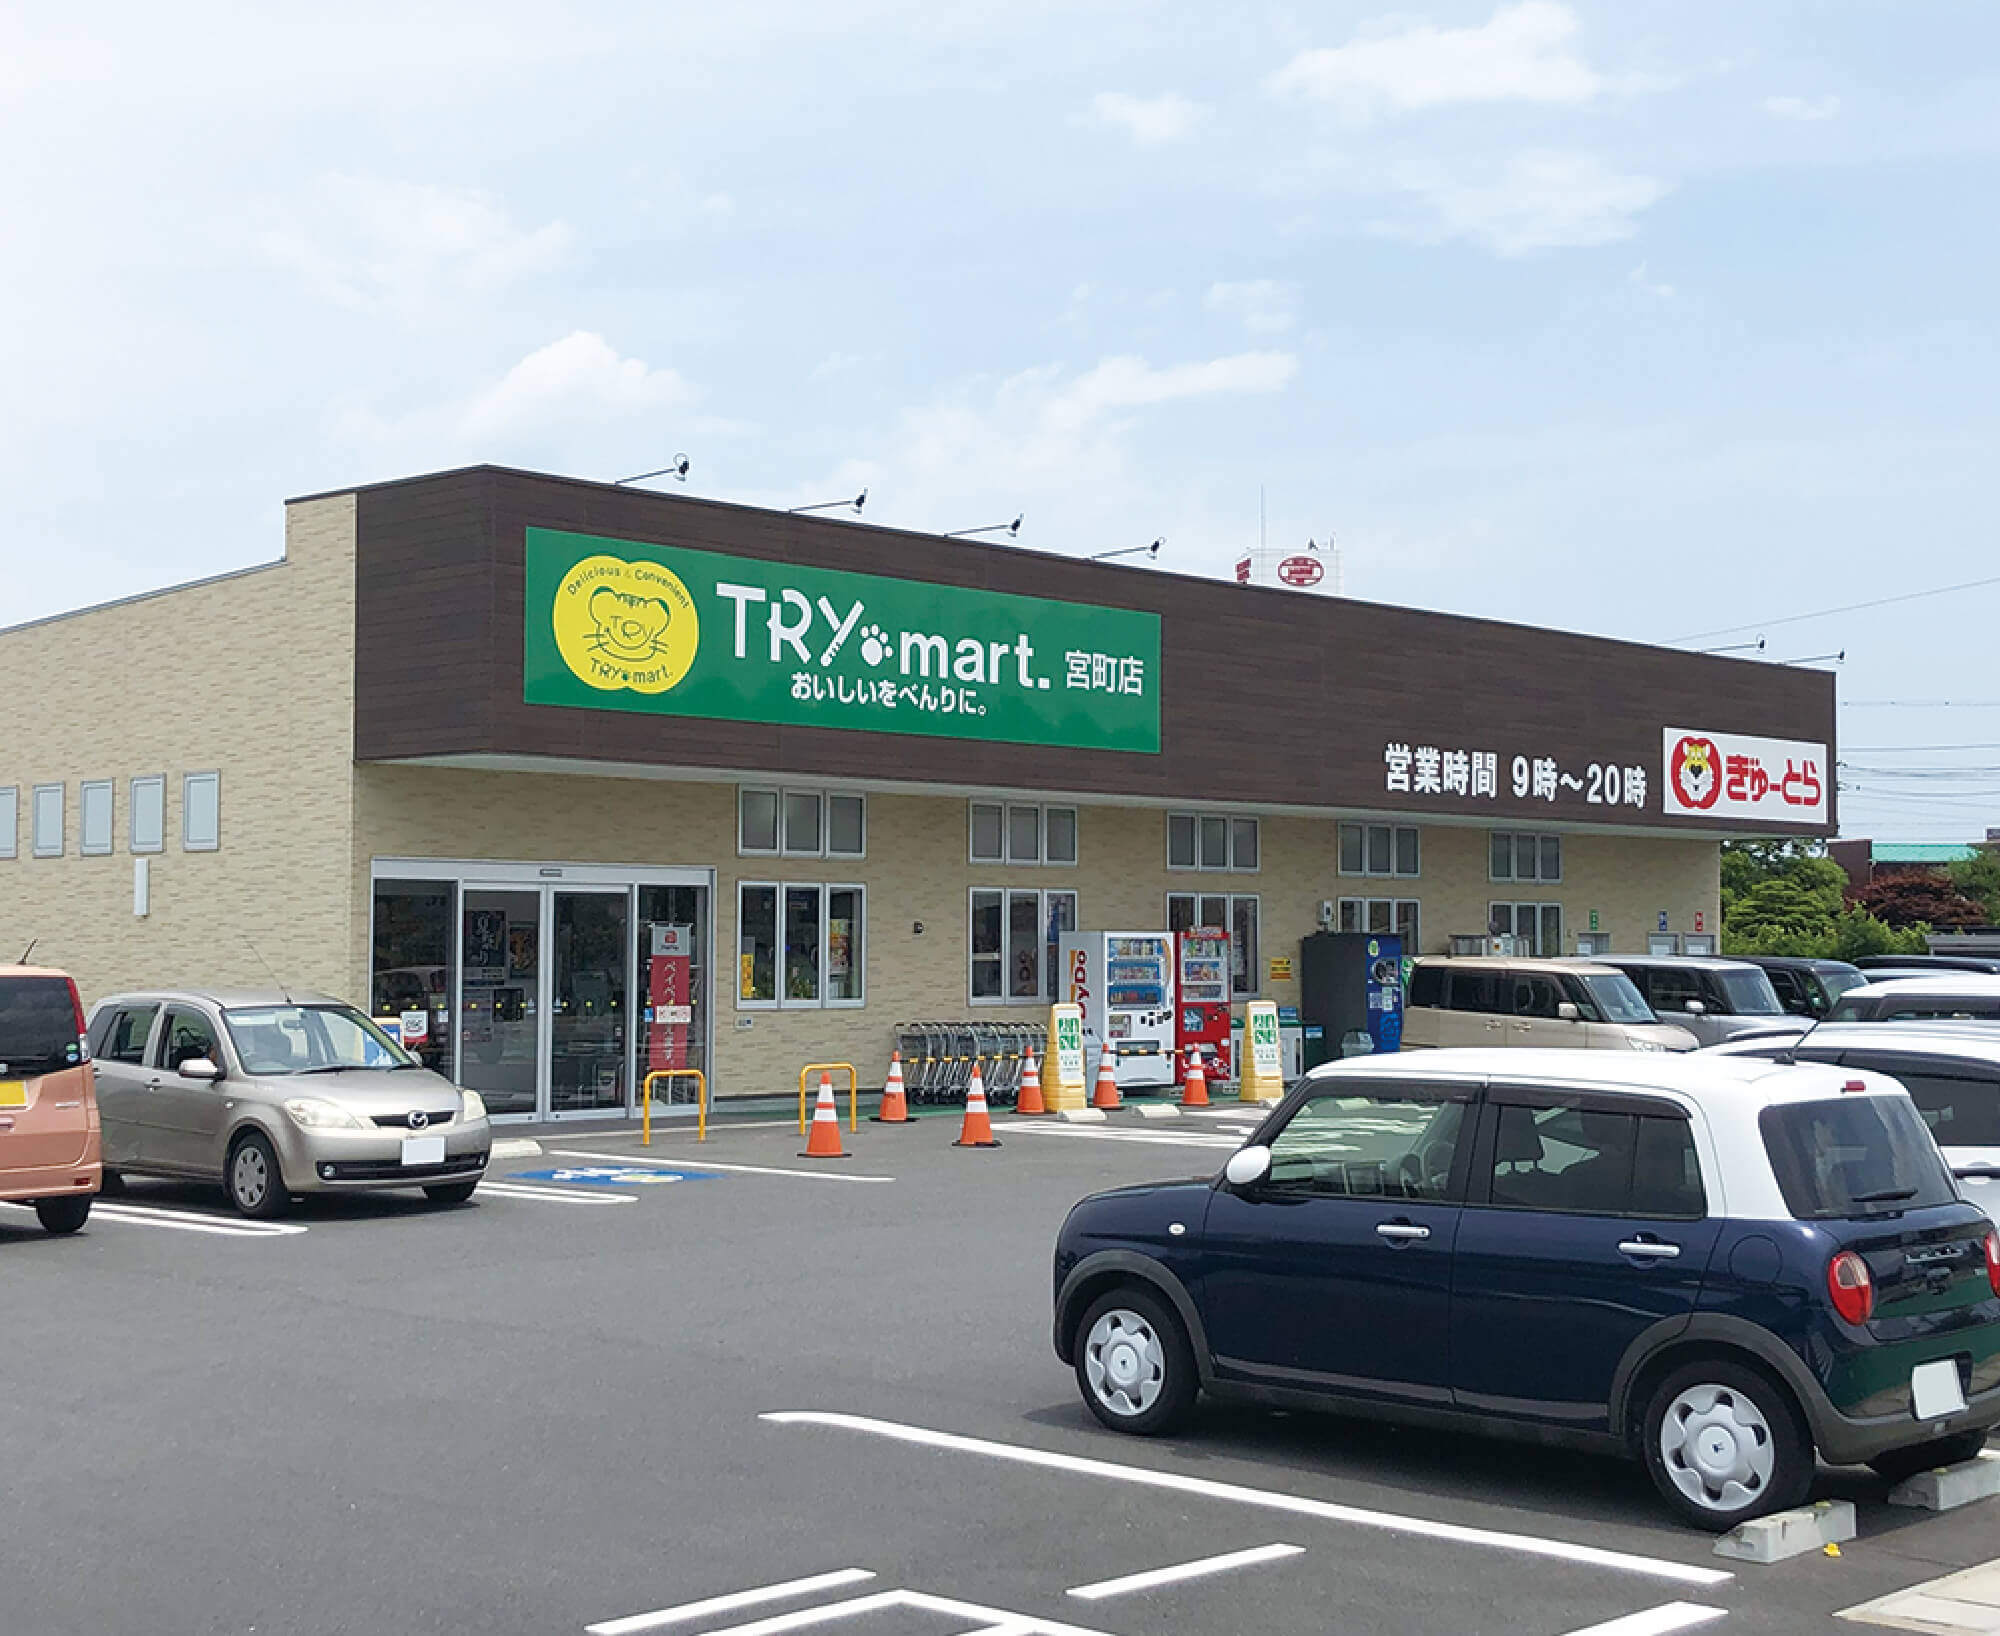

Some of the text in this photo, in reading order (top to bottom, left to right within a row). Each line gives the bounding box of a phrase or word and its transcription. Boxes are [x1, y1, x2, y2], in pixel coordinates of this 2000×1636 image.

[567, 566, 621, 595] Delicious
[634, 569, 689, 609] Convenient
[716, 581, 865, 667] TRY
[790, 671, 987, 717] おいしいをべんりに。
[1064, 649, 1144, 697] 宮町店
[1384, 743, 1498, 799] 営業時間
[1726, 754, 1821, 807] ぎゅーとら
